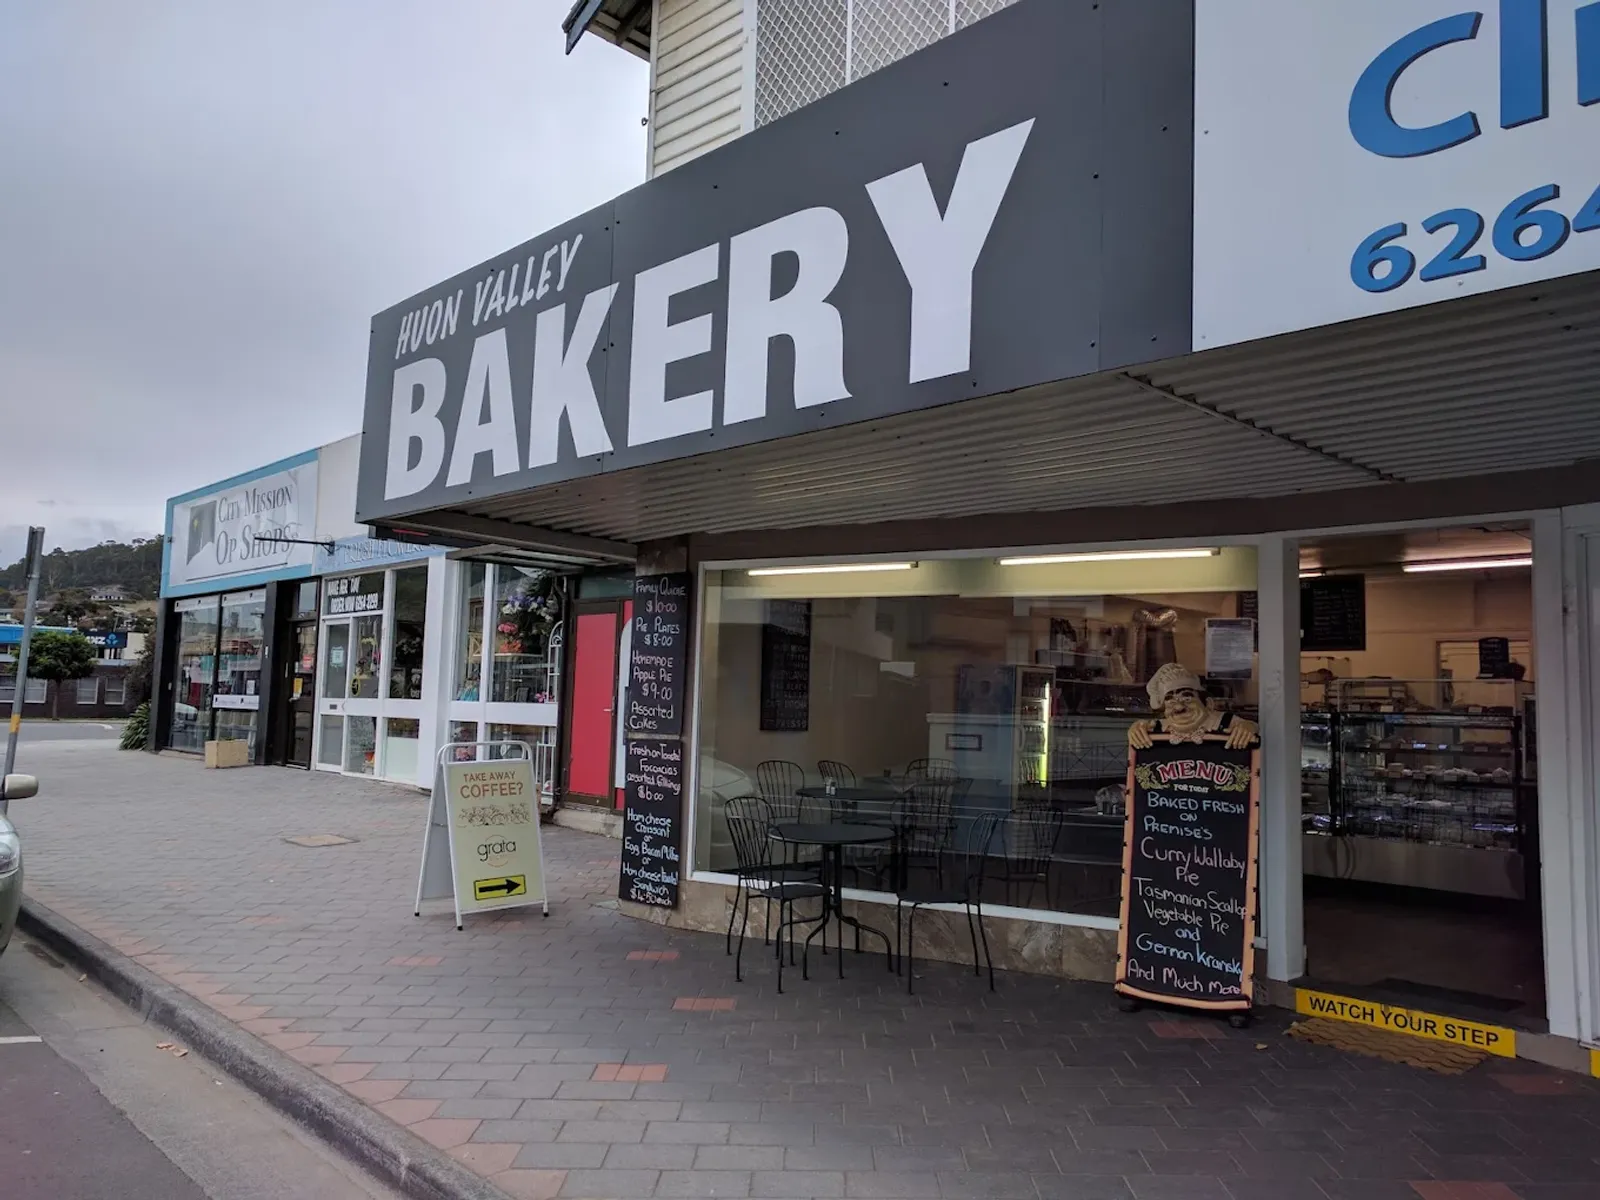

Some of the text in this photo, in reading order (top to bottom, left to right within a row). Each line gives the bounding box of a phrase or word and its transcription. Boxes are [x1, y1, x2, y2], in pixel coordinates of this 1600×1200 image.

[394, 233, 584, 360] HUON VALLEY
[383, 117, 1037, 501] BAKERY
[463, 770, 516, 782] TAKE AWAY
[1156, 759, 1233, 785] MENU
[460, 781, 524, 799] COFFEE?
[1173, 783, 1209, 793] FOR TODAY
[1147, 791, 1245, 814] BAKED FRESH
[1180, 813, 1198, 822] ON
[477, 840, 517, 862] grata
[624, 836, 641, 857] Egg
[1141, 836, 1245, 879] Curry Wallaby
[1175, 866, 1200, 886] Pie
[1133, 877, 1207, 909] Tasmanian
[1143, 899, 1230, 936] Vegetable Pie
[1175, 926, 1201, 942] and
[1135, 932, 1194, 962] German
[1128, 959, 1241, 996] And Much More
[1309, 996, 1499, 1047] WATCH YOUR STEP
